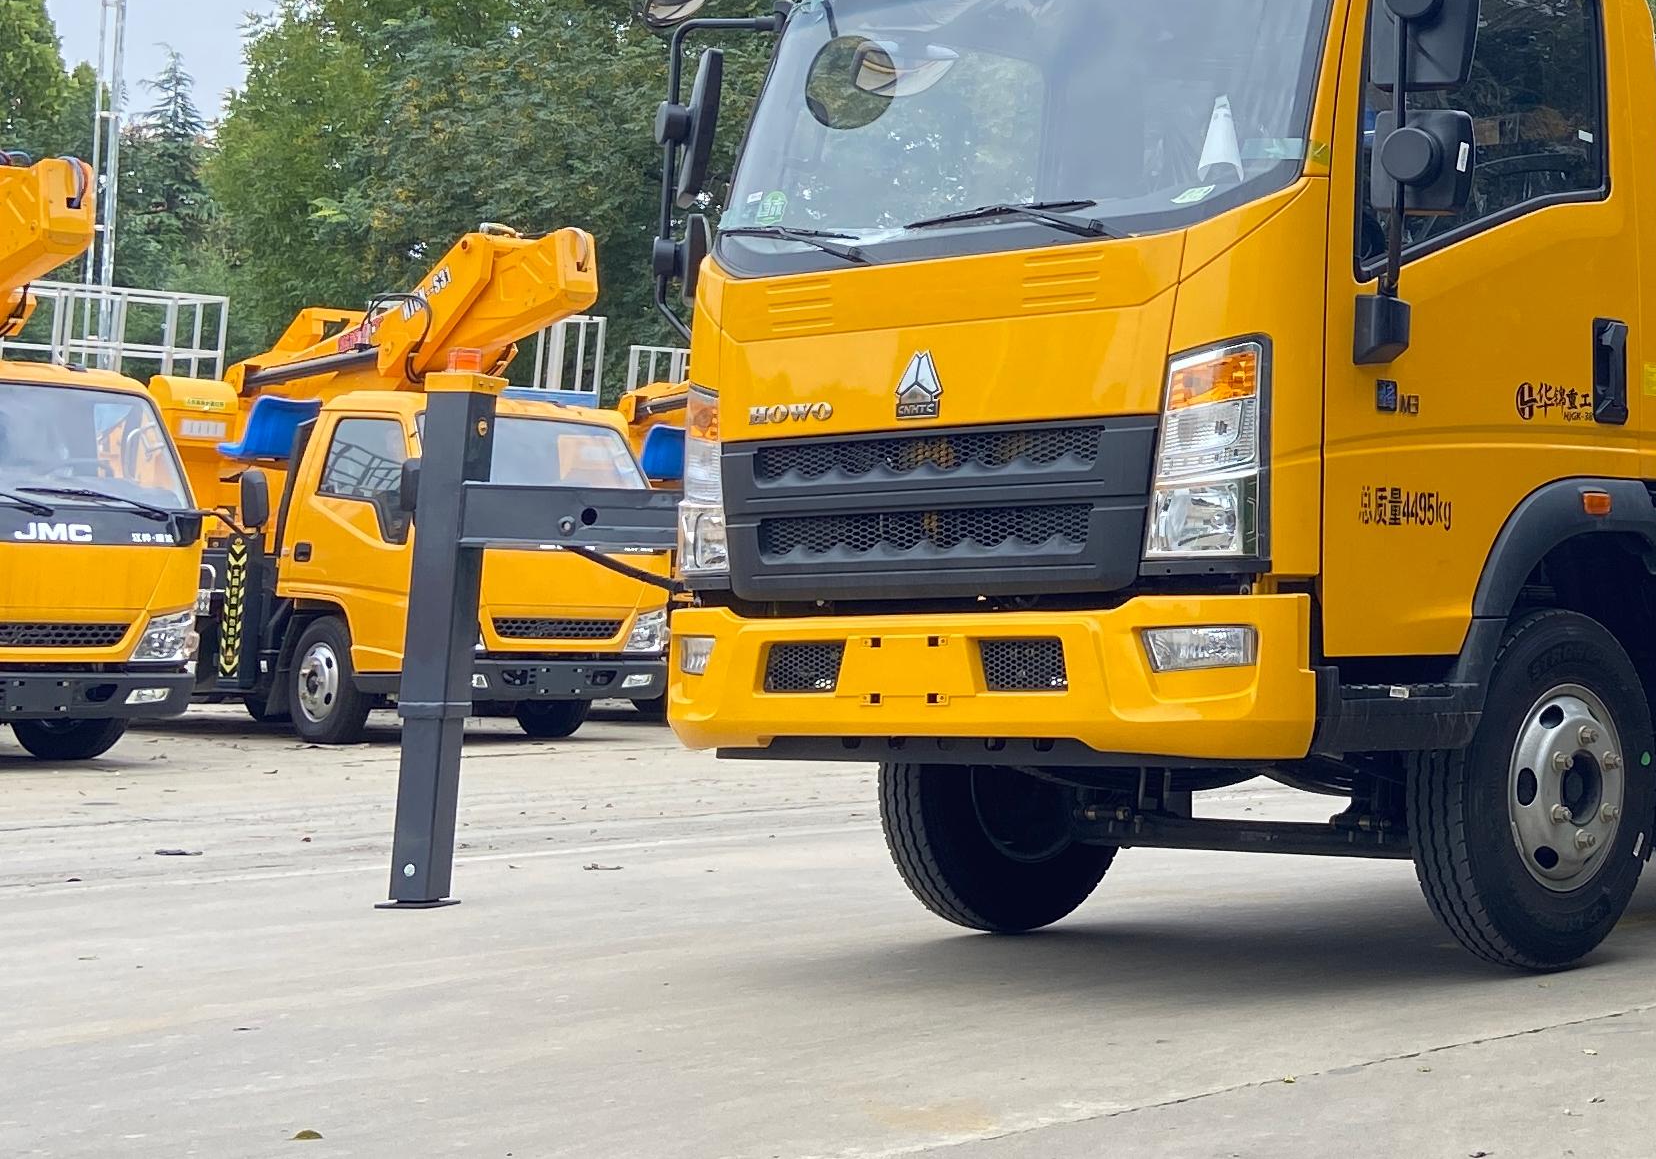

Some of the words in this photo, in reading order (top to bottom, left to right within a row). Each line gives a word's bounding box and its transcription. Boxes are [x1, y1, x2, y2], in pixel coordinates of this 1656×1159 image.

[897, 403, 935, 415] CNHTC
[1536, 382, 1592, 418] 华锦重工
[749, 401, 833, 426] HOWO
[1359, 485, 1452, 532] 总质量4495kg
[14, 522, 93, 542] JMC
